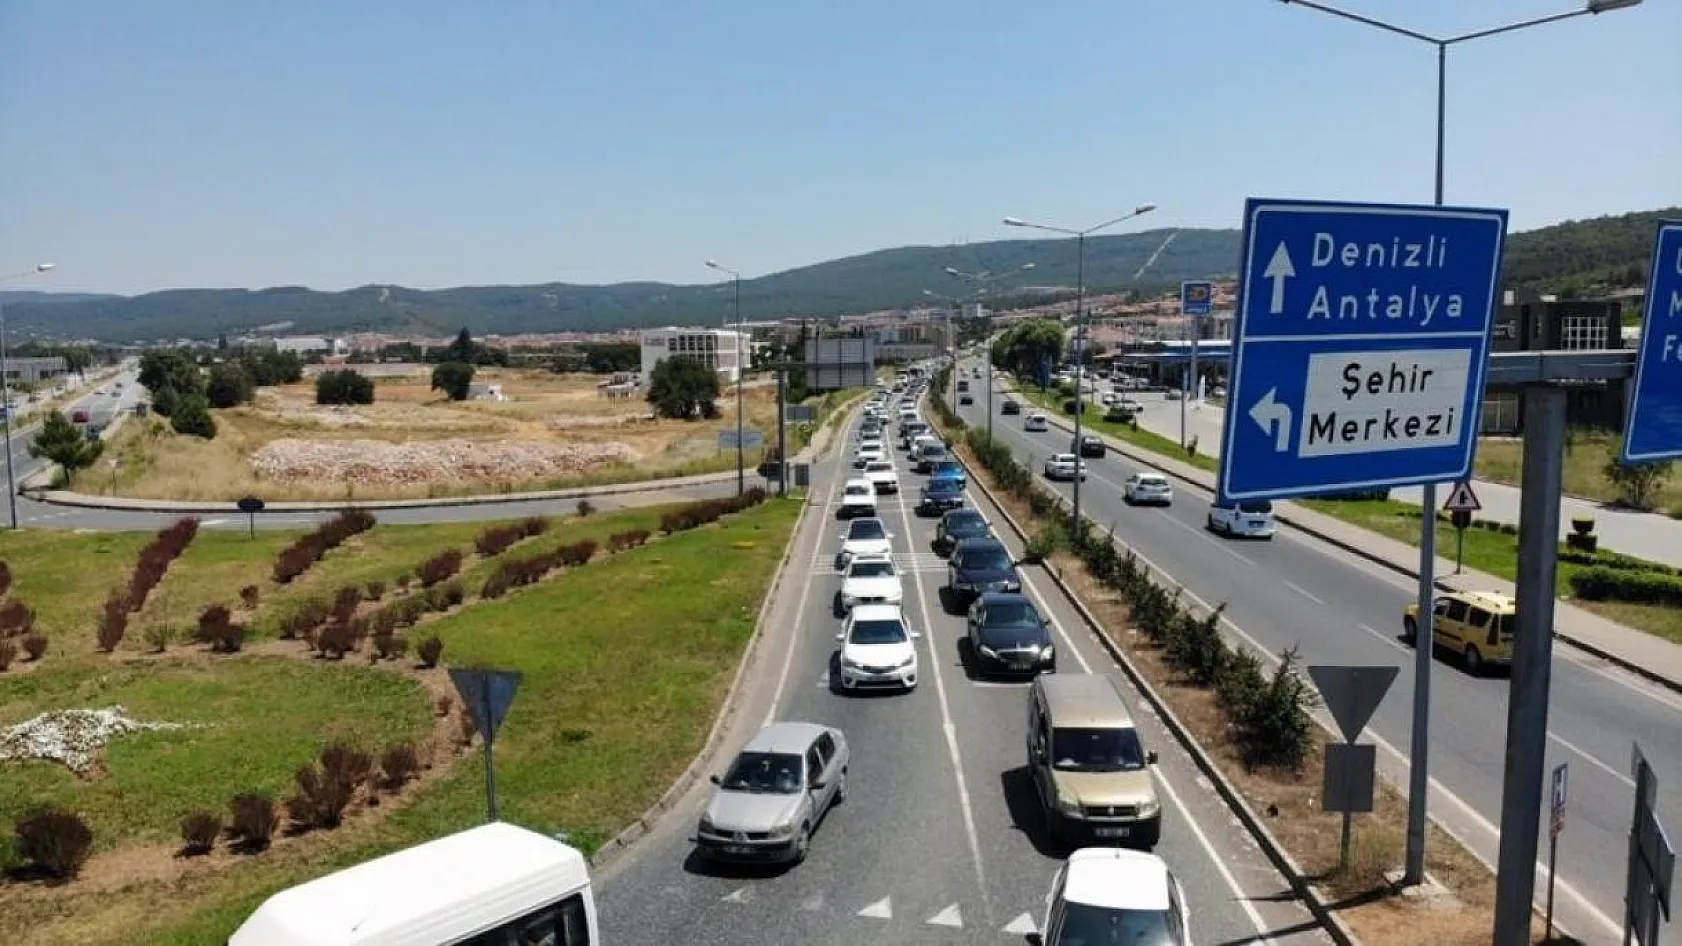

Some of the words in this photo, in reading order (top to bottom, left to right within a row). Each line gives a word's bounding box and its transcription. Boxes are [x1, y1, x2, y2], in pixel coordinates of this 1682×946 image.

[1312, 232, 1447, 268] Denizli
[1306, 285, 1463, 326] Antalya
[1341, 362, 1434, 400] Şehir
[1307, 406, 1455, 446] Merkezi
